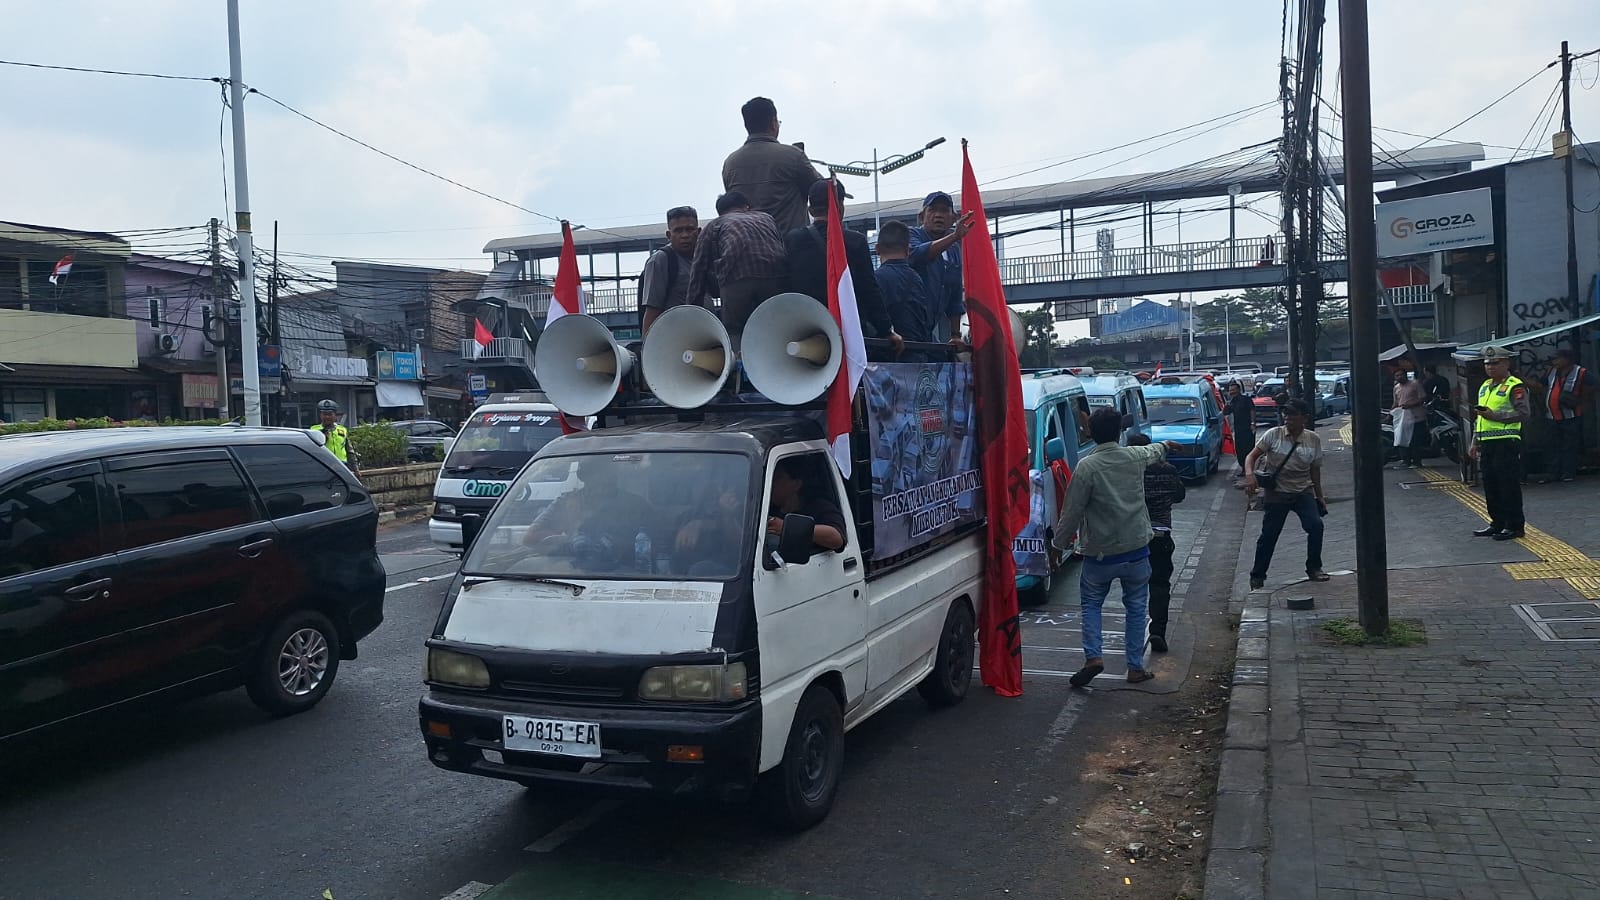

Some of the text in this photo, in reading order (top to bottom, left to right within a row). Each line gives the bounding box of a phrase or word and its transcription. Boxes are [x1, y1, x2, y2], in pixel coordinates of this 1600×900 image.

[1415, 213, 1476, 230] GROZA
[396, 358, 413, 366] TOKO
[881, 485, 926, 522] PERSATUAN
[912, 503, 948, 538] MIKROLET
[506, 718, 596, 745] B 9815 EA
